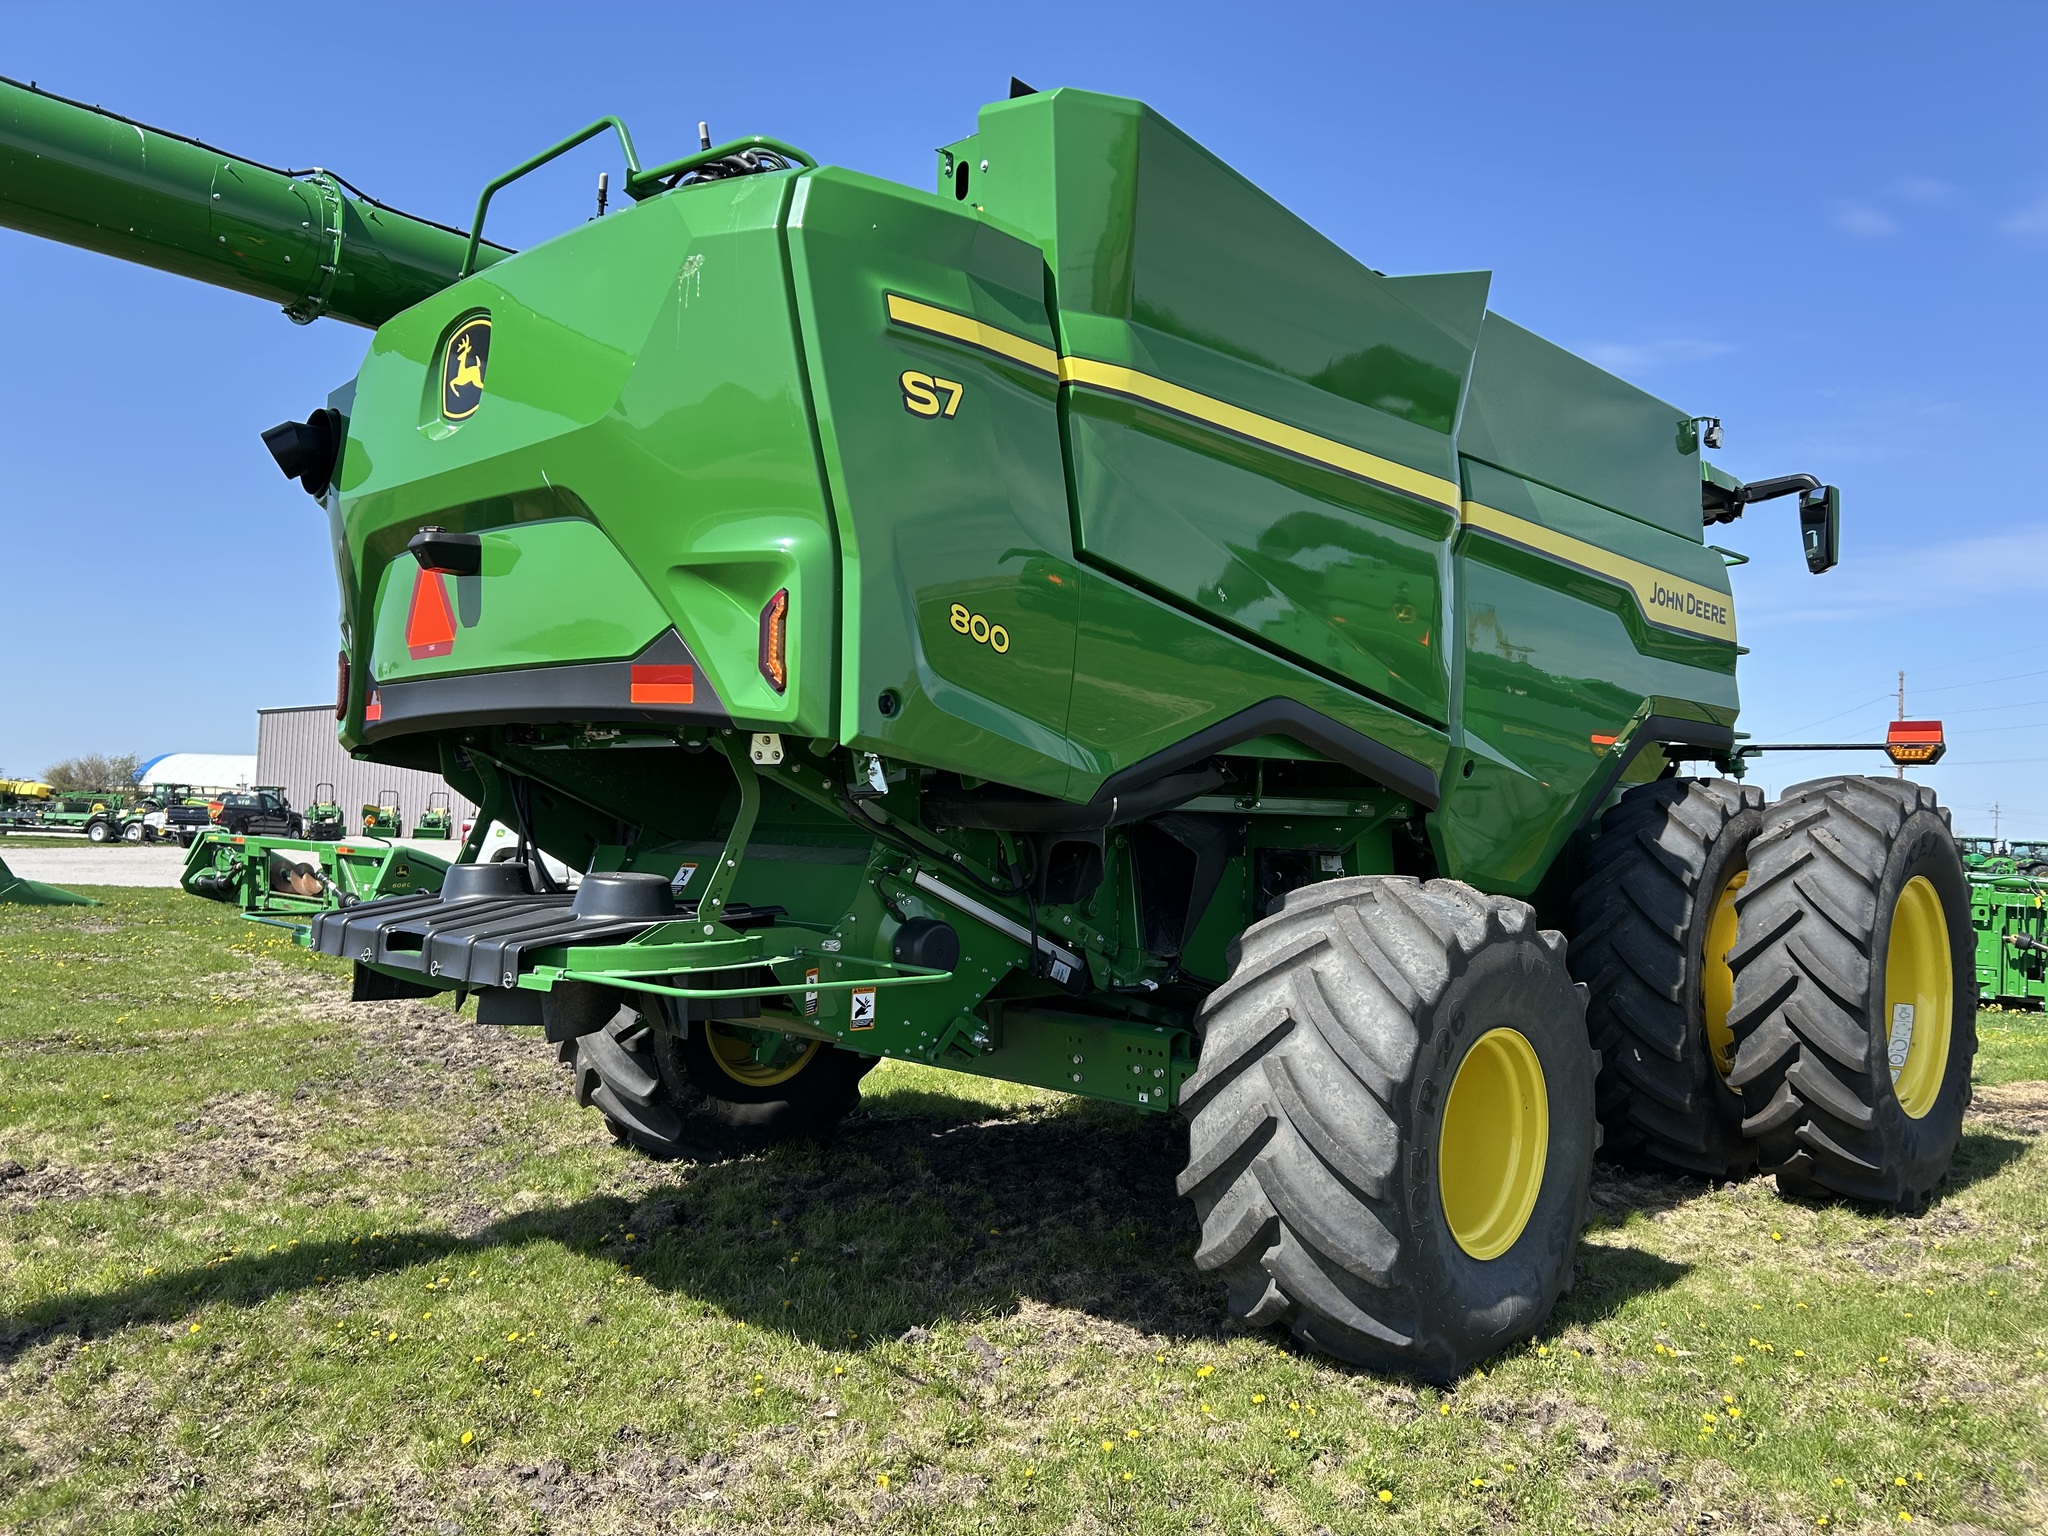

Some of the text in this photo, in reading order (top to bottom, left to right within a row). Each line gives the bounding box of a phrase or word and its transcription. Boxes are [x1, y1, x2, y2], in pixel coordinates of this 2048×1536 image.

[899, 369, 964, 420] S7
[949, 602, 1010, 654] 800
[1649, 581, 1726, 625] JOHN DEERE
